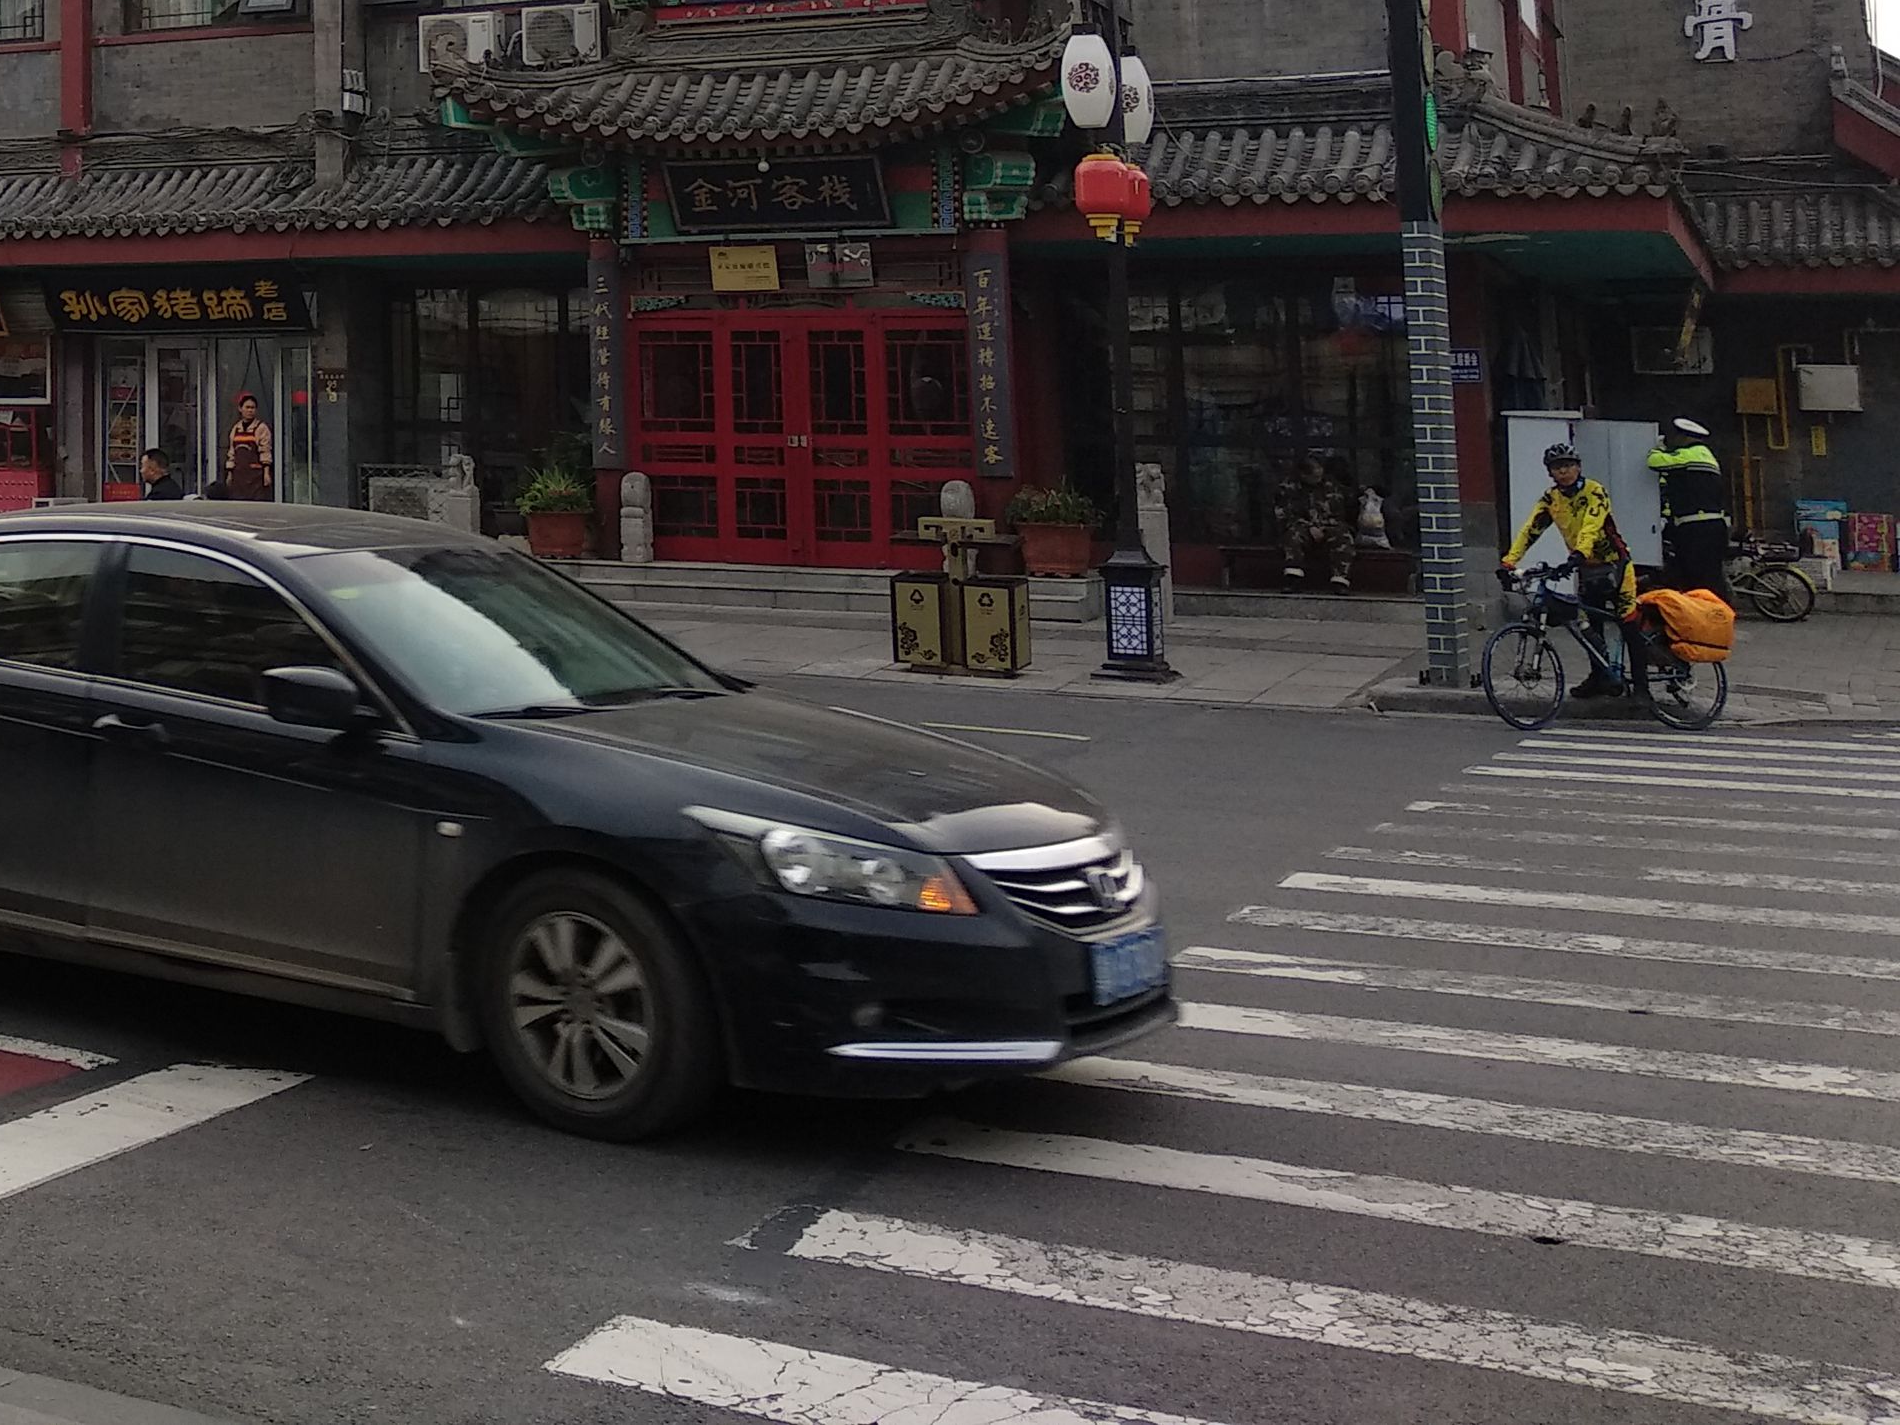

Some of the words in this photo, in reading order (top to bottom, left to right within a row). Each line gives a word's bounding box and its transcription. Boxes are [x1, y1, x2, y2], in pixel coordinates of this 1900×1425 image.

[684, 175, 859, 212] 金河客栈
[59, 286, 255, 324] 孙家猪蹄
[253, 277, 289, 322] 老店
